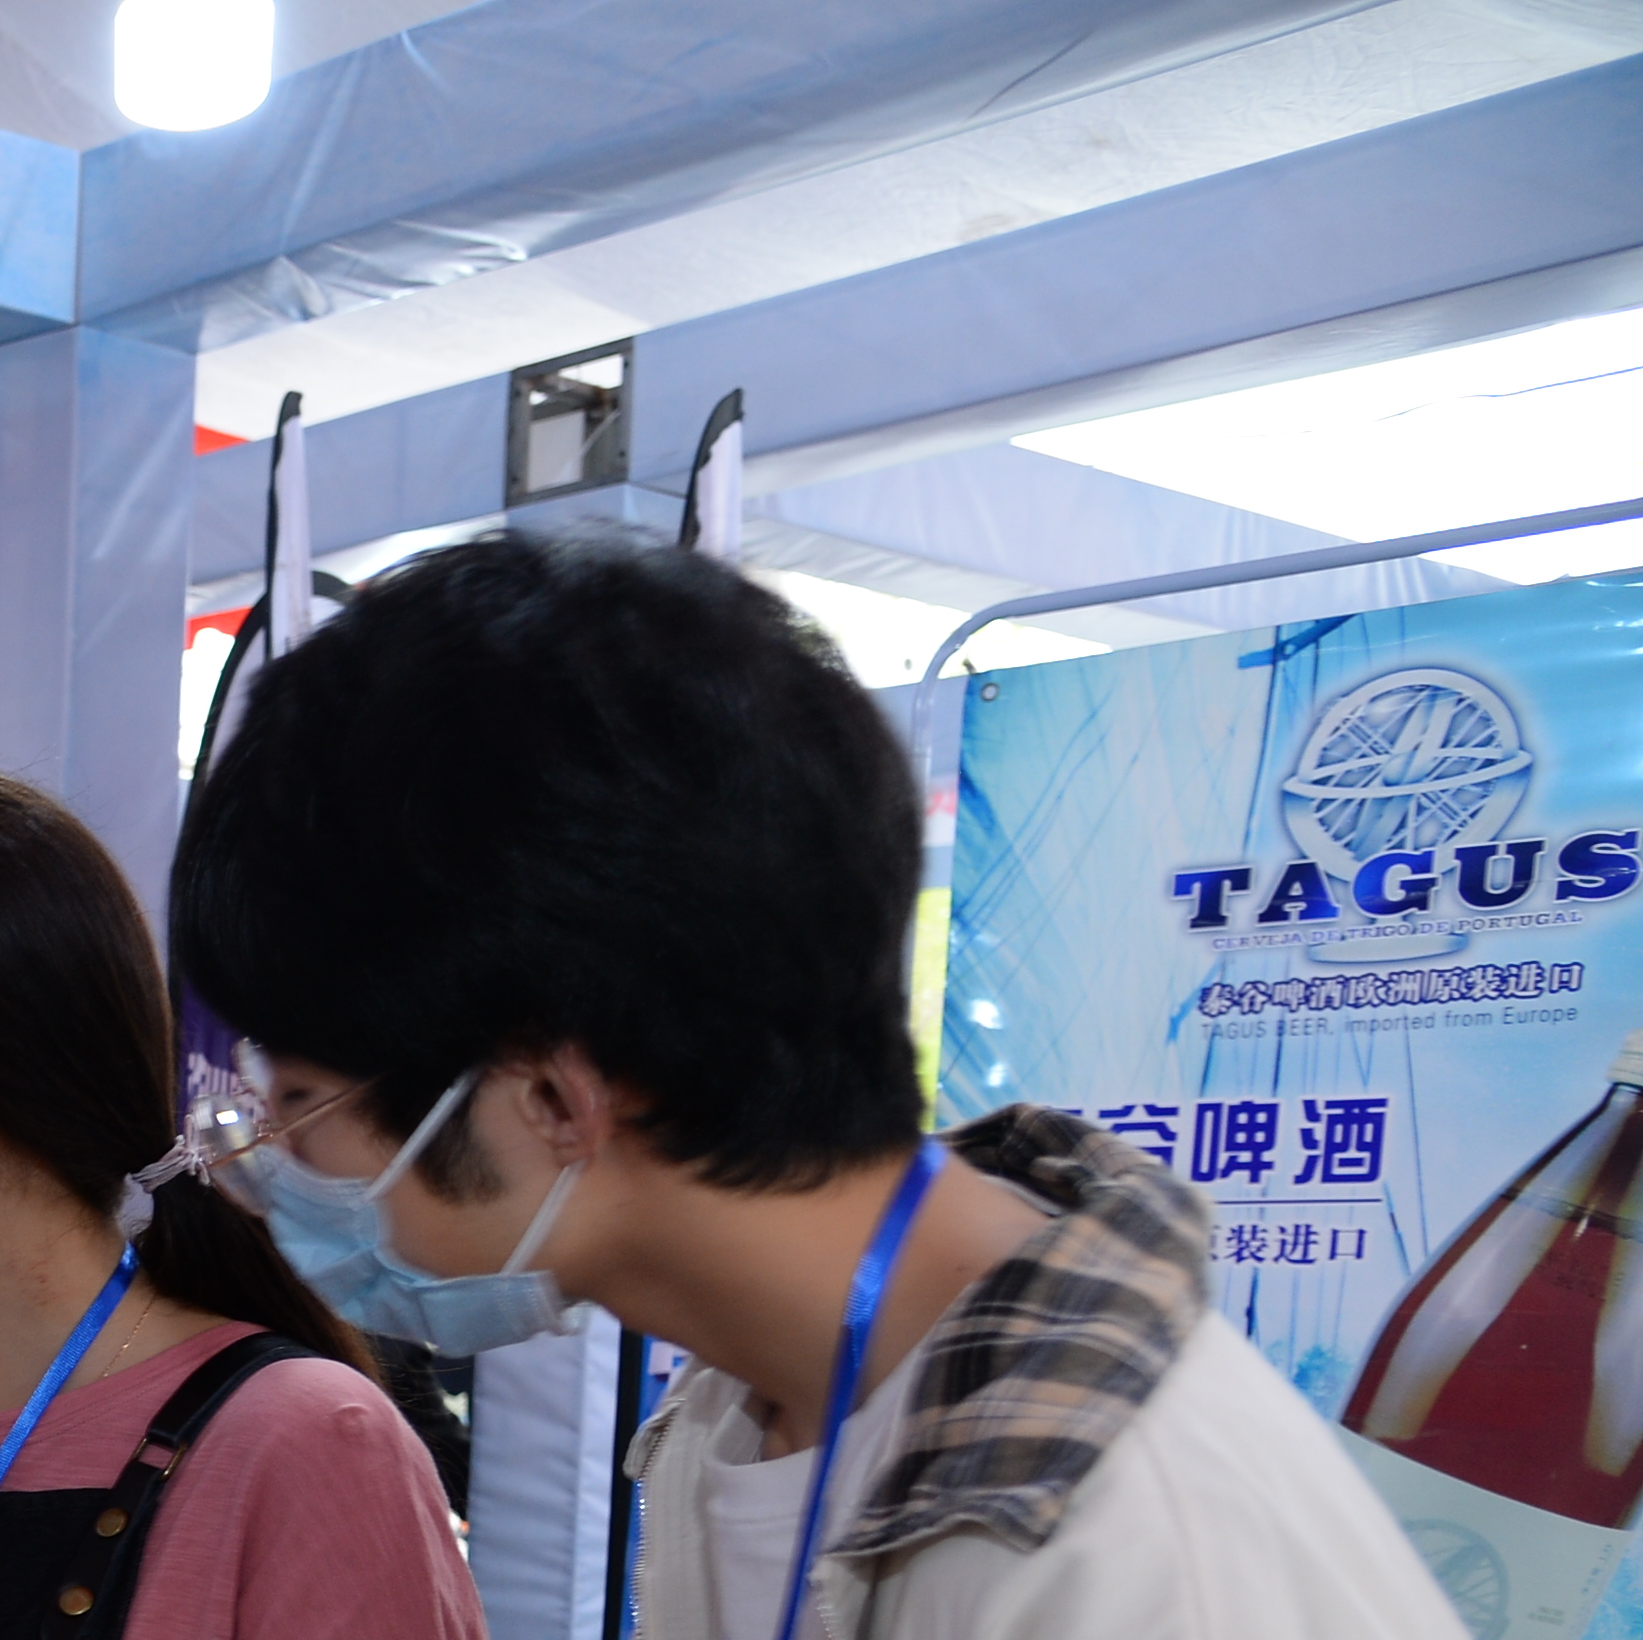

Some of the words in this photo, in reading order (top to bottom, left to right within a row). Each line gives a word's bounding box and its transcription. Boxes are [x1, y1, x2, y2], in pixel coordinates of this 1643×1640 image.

[1173, 829, 1642, 930] TAGUS
[1213, 932, 1303, 951] CERVEJA
[1310, 928, 1339, 944] DE
[1347, 923, 1412, 942] TRIGO
[1420, 920, 1448, 936] DE
[1458, 910, 1582, 935] PORTUGAL
[1199, 961, 1584, 1017] 泰谷啤酒欧洲原装进口
[1201, 1018, 1267, 1042] TAGUS
[1344, 1010, 1435, 1036] imported
[1445, 1010, 1492, 1028] from
[1503, 1004, 1578, 1027] Europe
[1211, 1223, 1367, 1265] 装进口
